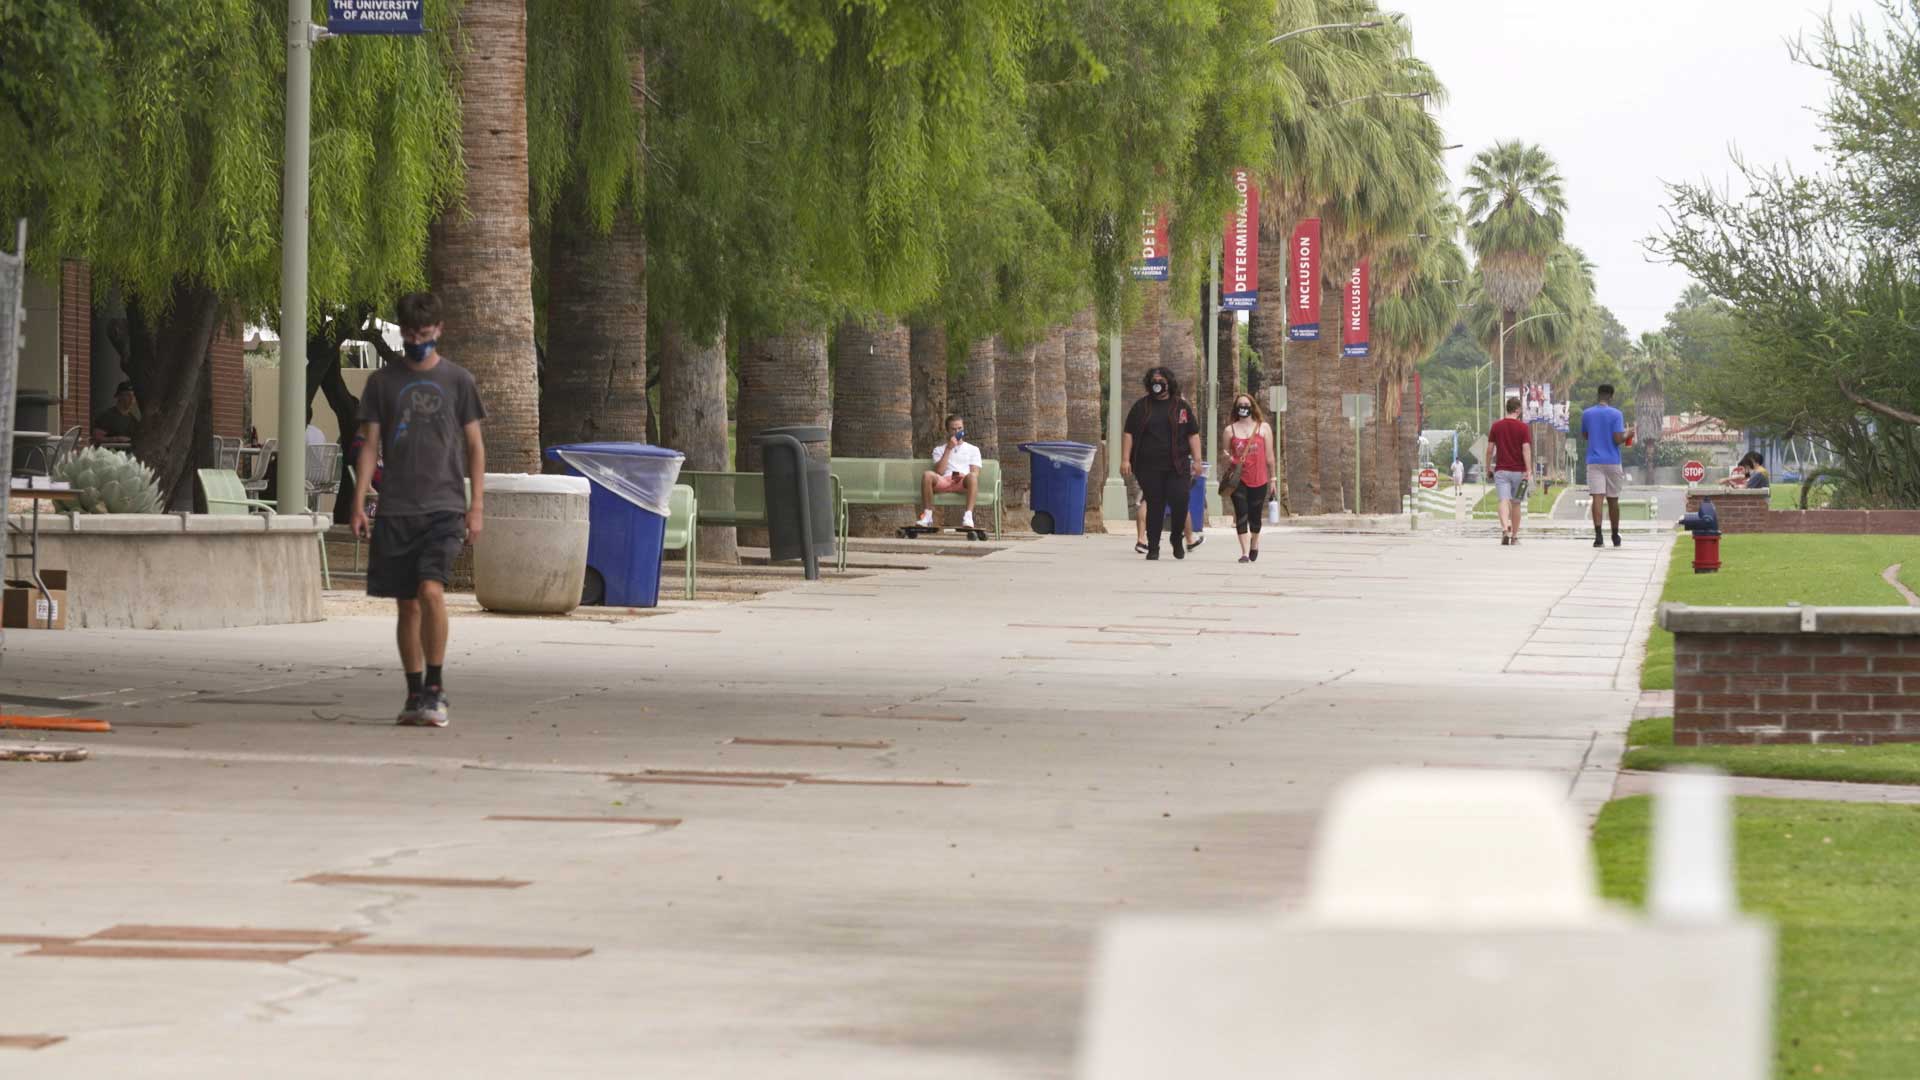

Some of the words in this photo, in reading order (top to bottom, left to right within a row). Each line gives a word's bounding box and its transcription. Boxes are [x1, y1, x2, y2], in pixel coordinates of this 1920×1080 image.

[333, 0, 353, 10] THE
[356, 0, 419, 10] UNIVERSITY
[343, 10, 357, 20] OF
[359, 10, 408, 20] ARIZONA
[1299, 237, 1310, 309] INCLUSION
[1684, 467, 1704, 477] STOP
